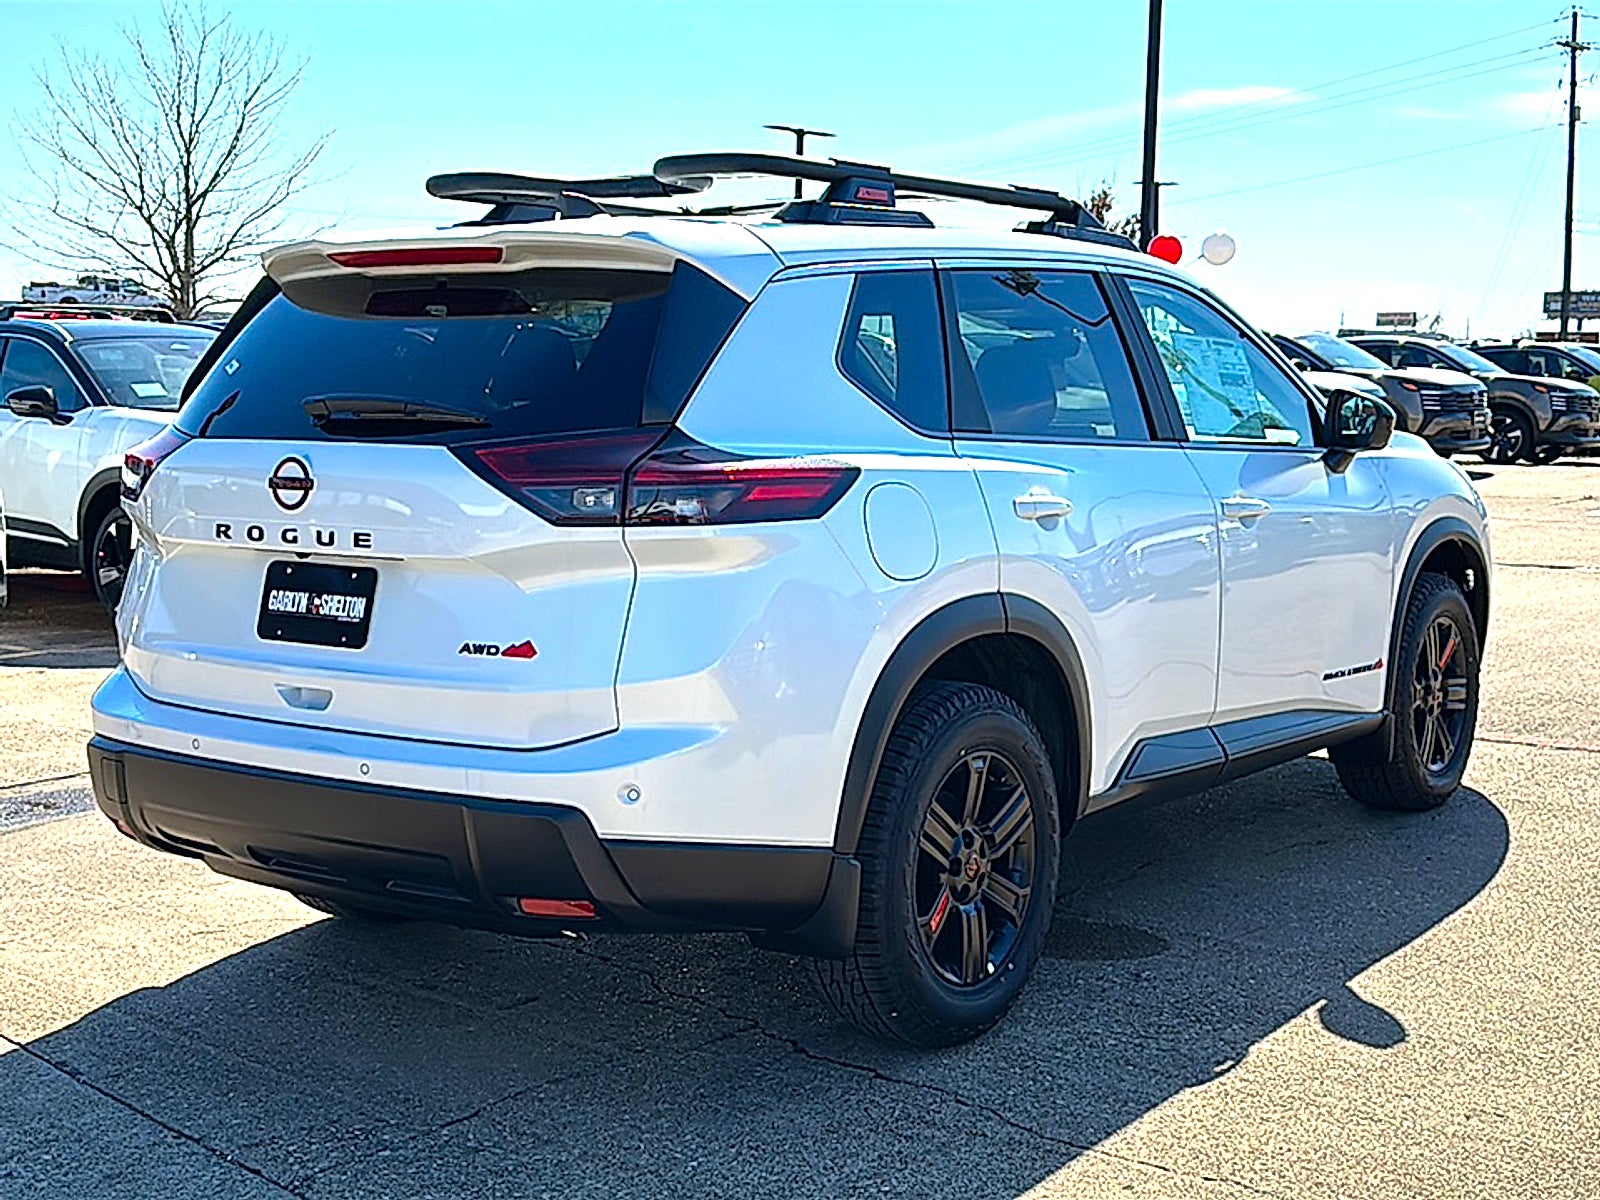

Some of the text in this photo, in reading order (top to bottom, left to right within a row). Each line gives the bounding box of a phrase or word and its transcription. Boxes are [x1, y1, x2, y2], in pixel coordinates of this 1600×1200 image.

[215, 523, 372, 549] ROGUE
[320, 594, 366, 618] SHELTON
[458, 642, 500, 656] AWD
